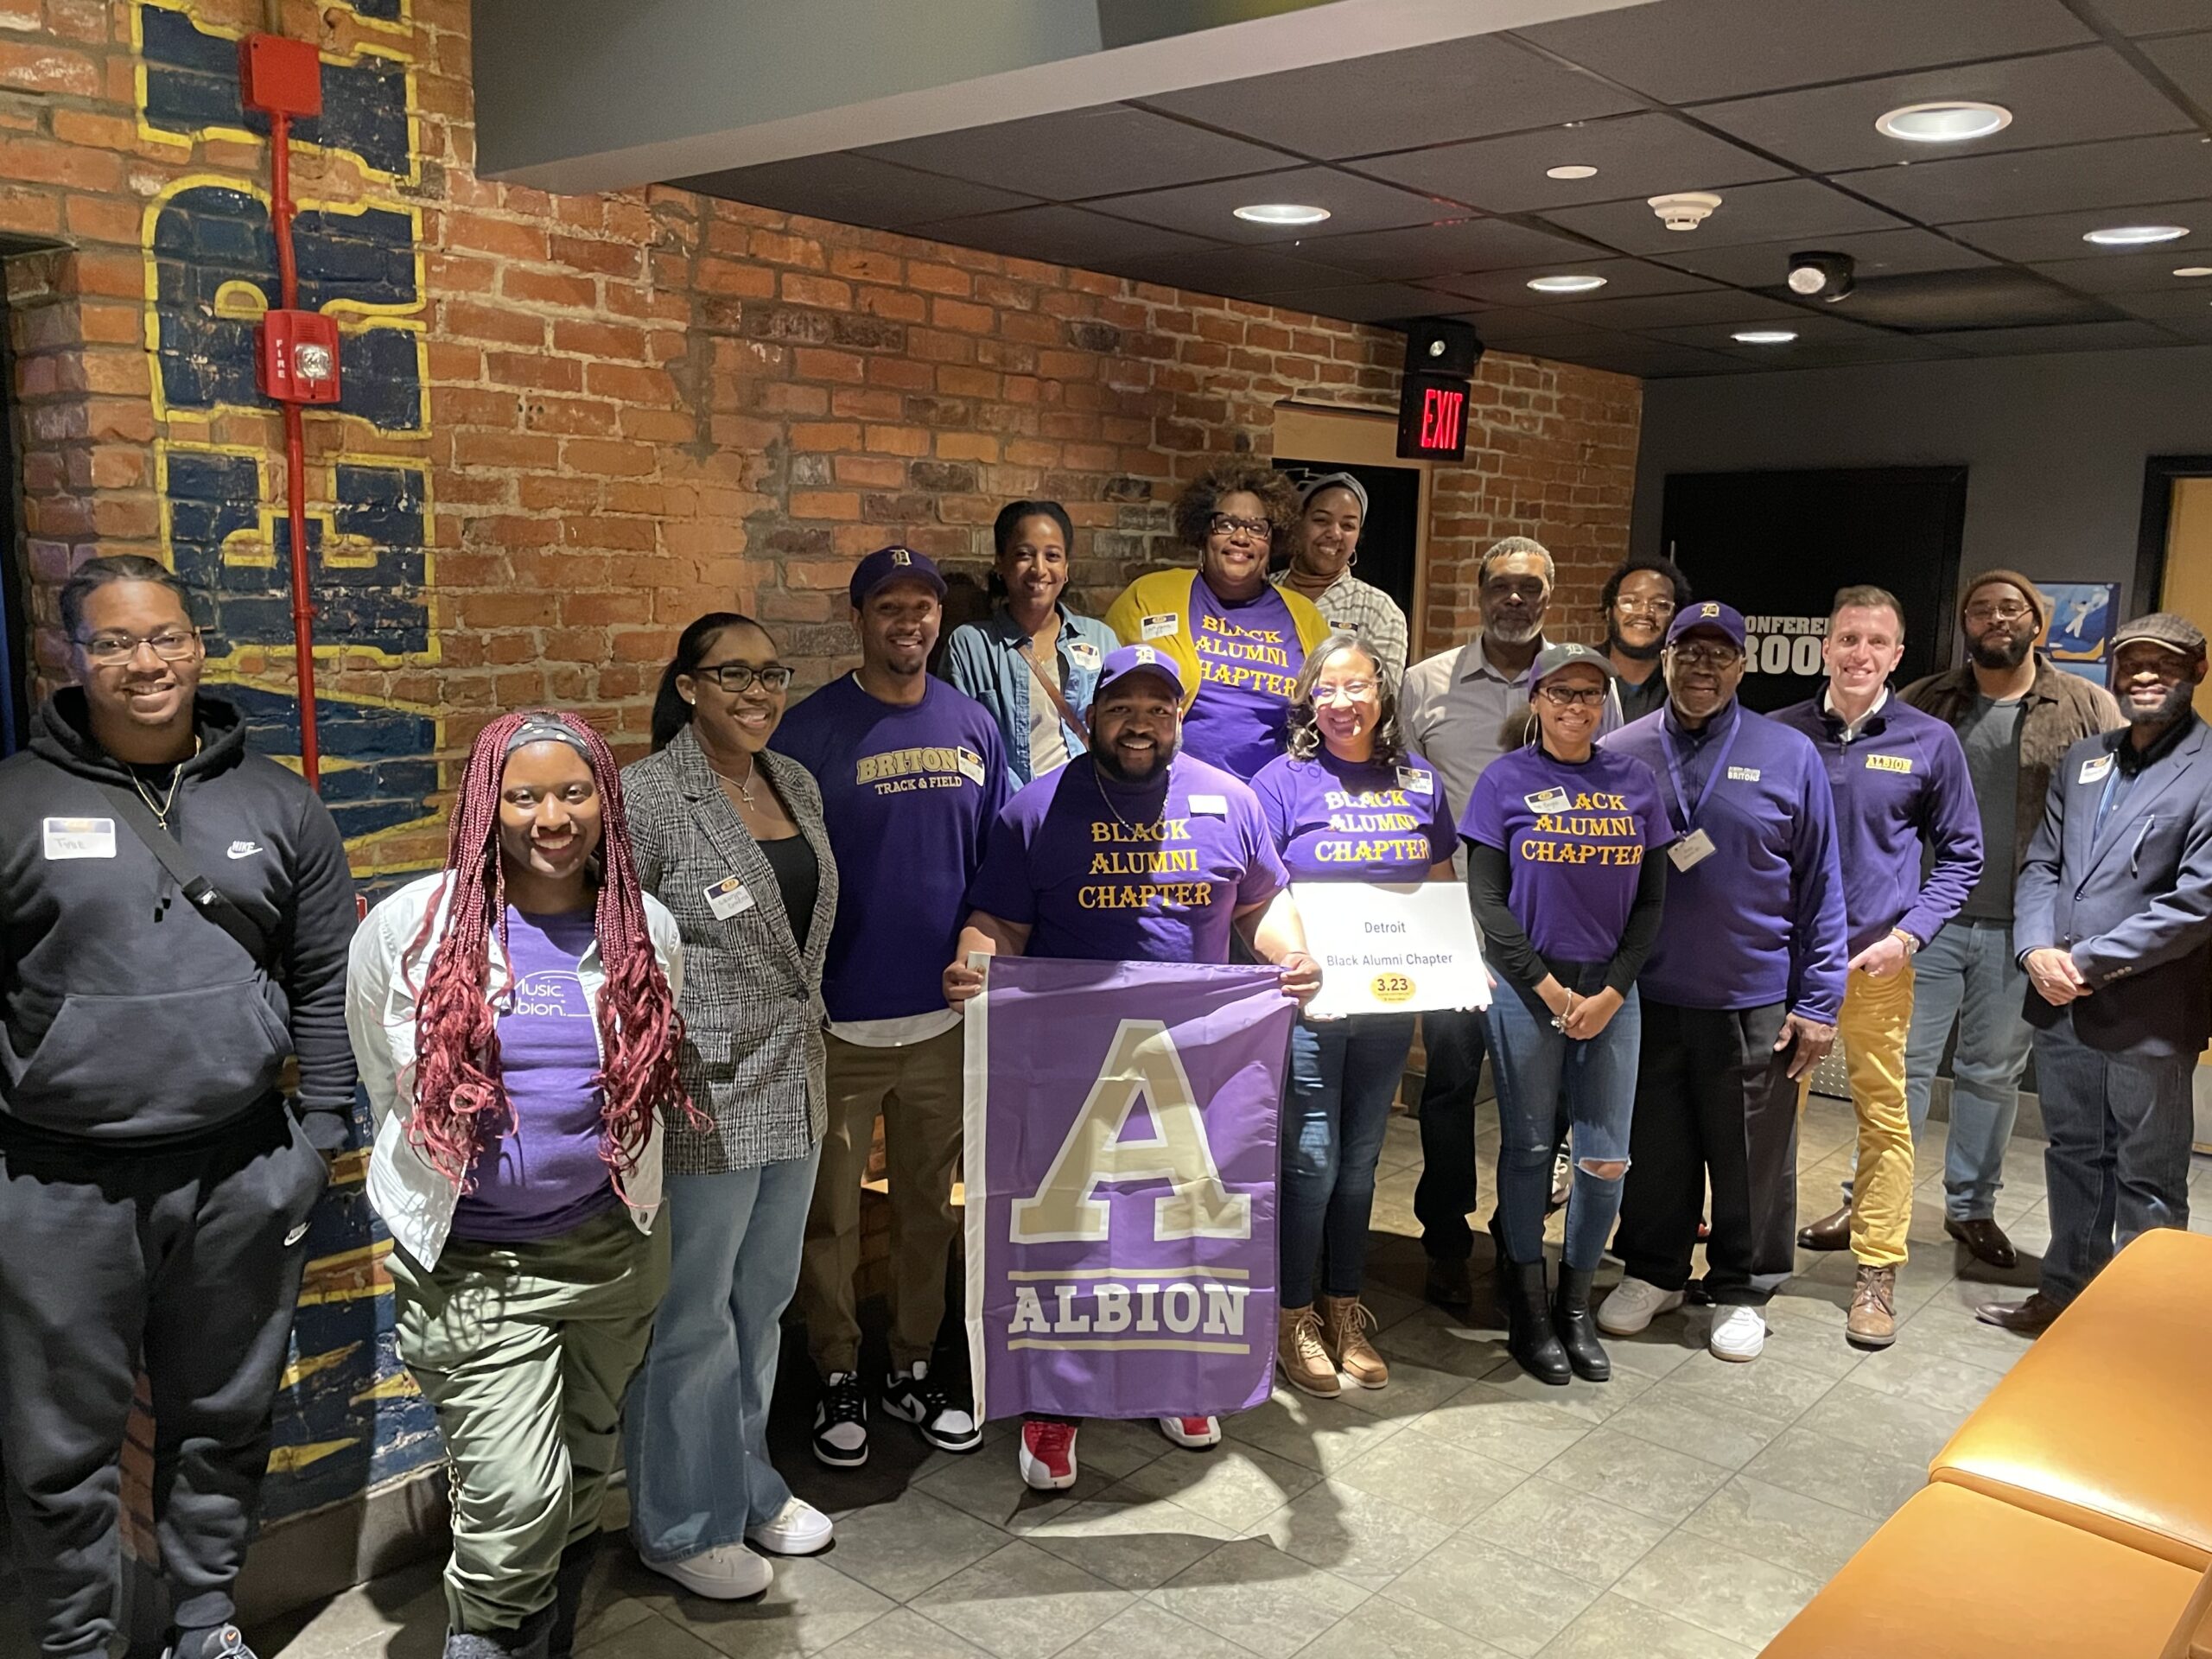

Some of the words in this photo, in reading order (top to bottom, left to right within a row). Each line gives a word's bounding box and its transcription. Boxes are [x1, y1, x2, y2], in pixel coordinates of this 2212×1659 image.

[276, 340, 286, 378] FIRE
[1421, 389, 1463, 449] EXIT
[1202, 614, 1284, 644] BLACK
[1745, 615, 1830, 635] ONFERE
[1195, 635, 1289, 668] ALUMNI
[1199, 658, 1298, 700] HAPTER
[856, 749, 958, 785] BRITON
[1866, 754, 1912, 773] ALBION
[874, 779, 917, 795] TRACK
[918, 778, 927, 789] &
[929, 776, 963, 788] FIELD
[1324, 790, 1410, 810] BLACK
[1572, 792, 1629, 810] ACK
[1091, 818, 1192, 842] BLACK
[1328, 813, 1419, 833] ALUMNI
[1533, 814, 1637, 836] ALUMNI
[232, 841, 255, 852] NIKE
[1314, 838, 1430, 862] CHAPTER
[1522, 840, 1643, 867] CHAPTER
[1089, 849, 1199, 874] ALUMNI
[1078, 882, 1211, 909] CHAPTER
[1364, 921, 1406, 933] Detroit
[1327, 955, 1358, 966] Black
[1363, 953, 1403, 966] Alumni
[1406, 953, 1452, 967] Chapter
[1377, 978, 1408, 991] 3.23
[1009, 1019, 1251, 1243] A
[1007, 1283, 1250, 1336] ALBION
